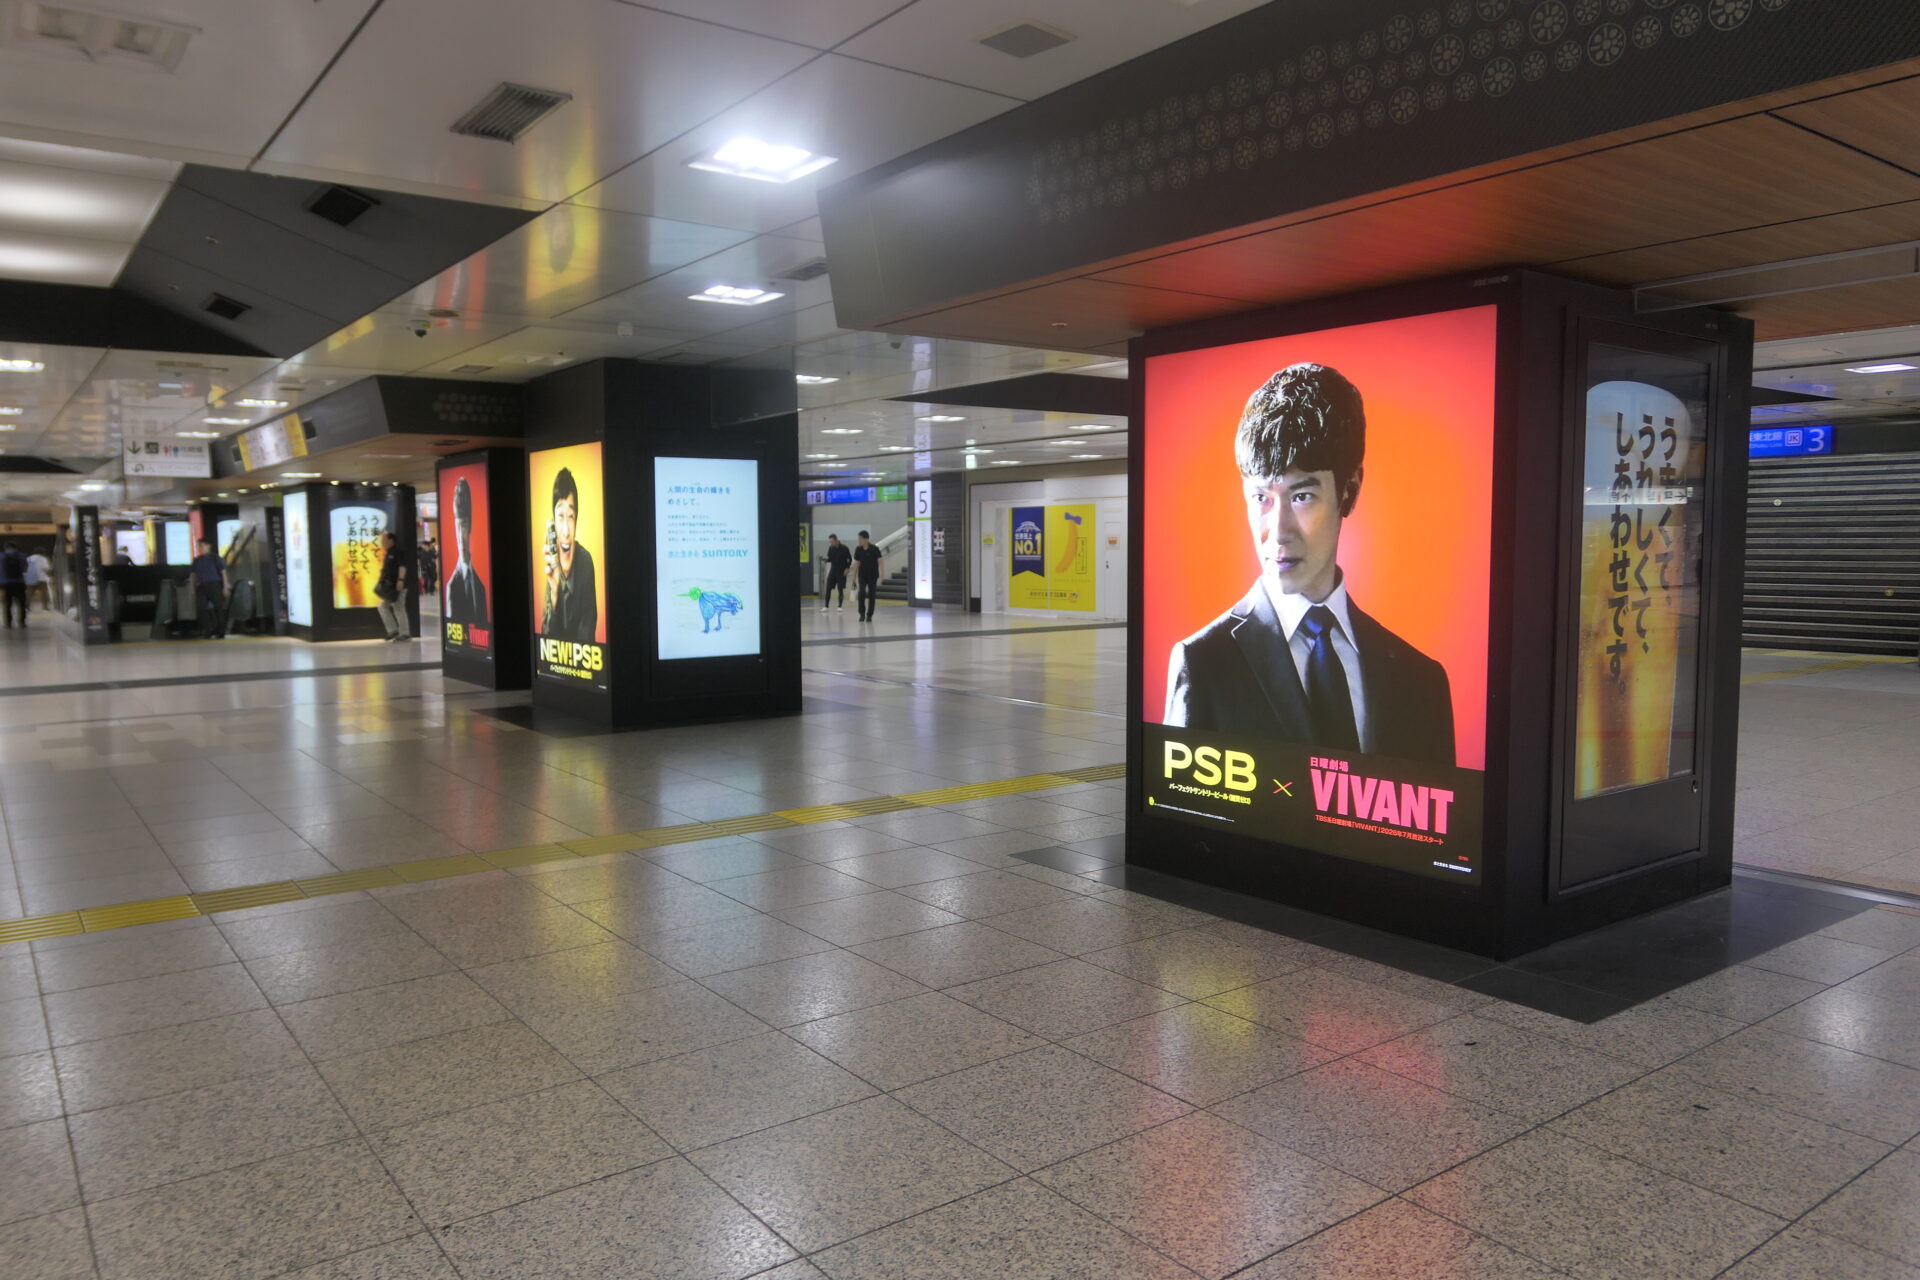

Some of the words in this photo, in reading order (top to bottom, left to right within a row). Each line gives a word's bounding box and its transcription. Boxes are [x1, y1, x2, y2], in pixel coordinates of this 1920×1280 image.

[1807, 429, 1825, 452] 3
[919, 490, 928, 514] 5
[702, 549, 749, 558] SUNTORY
[1015, 532, 1042, 555] NO.1
[446, 622, 463, 641] PSB
[1164, 741, 1257, 791] PSB
[1310, 756, 1349, 772] 日曜劇場
[1310, 768, 1454, 835] VIVANT
